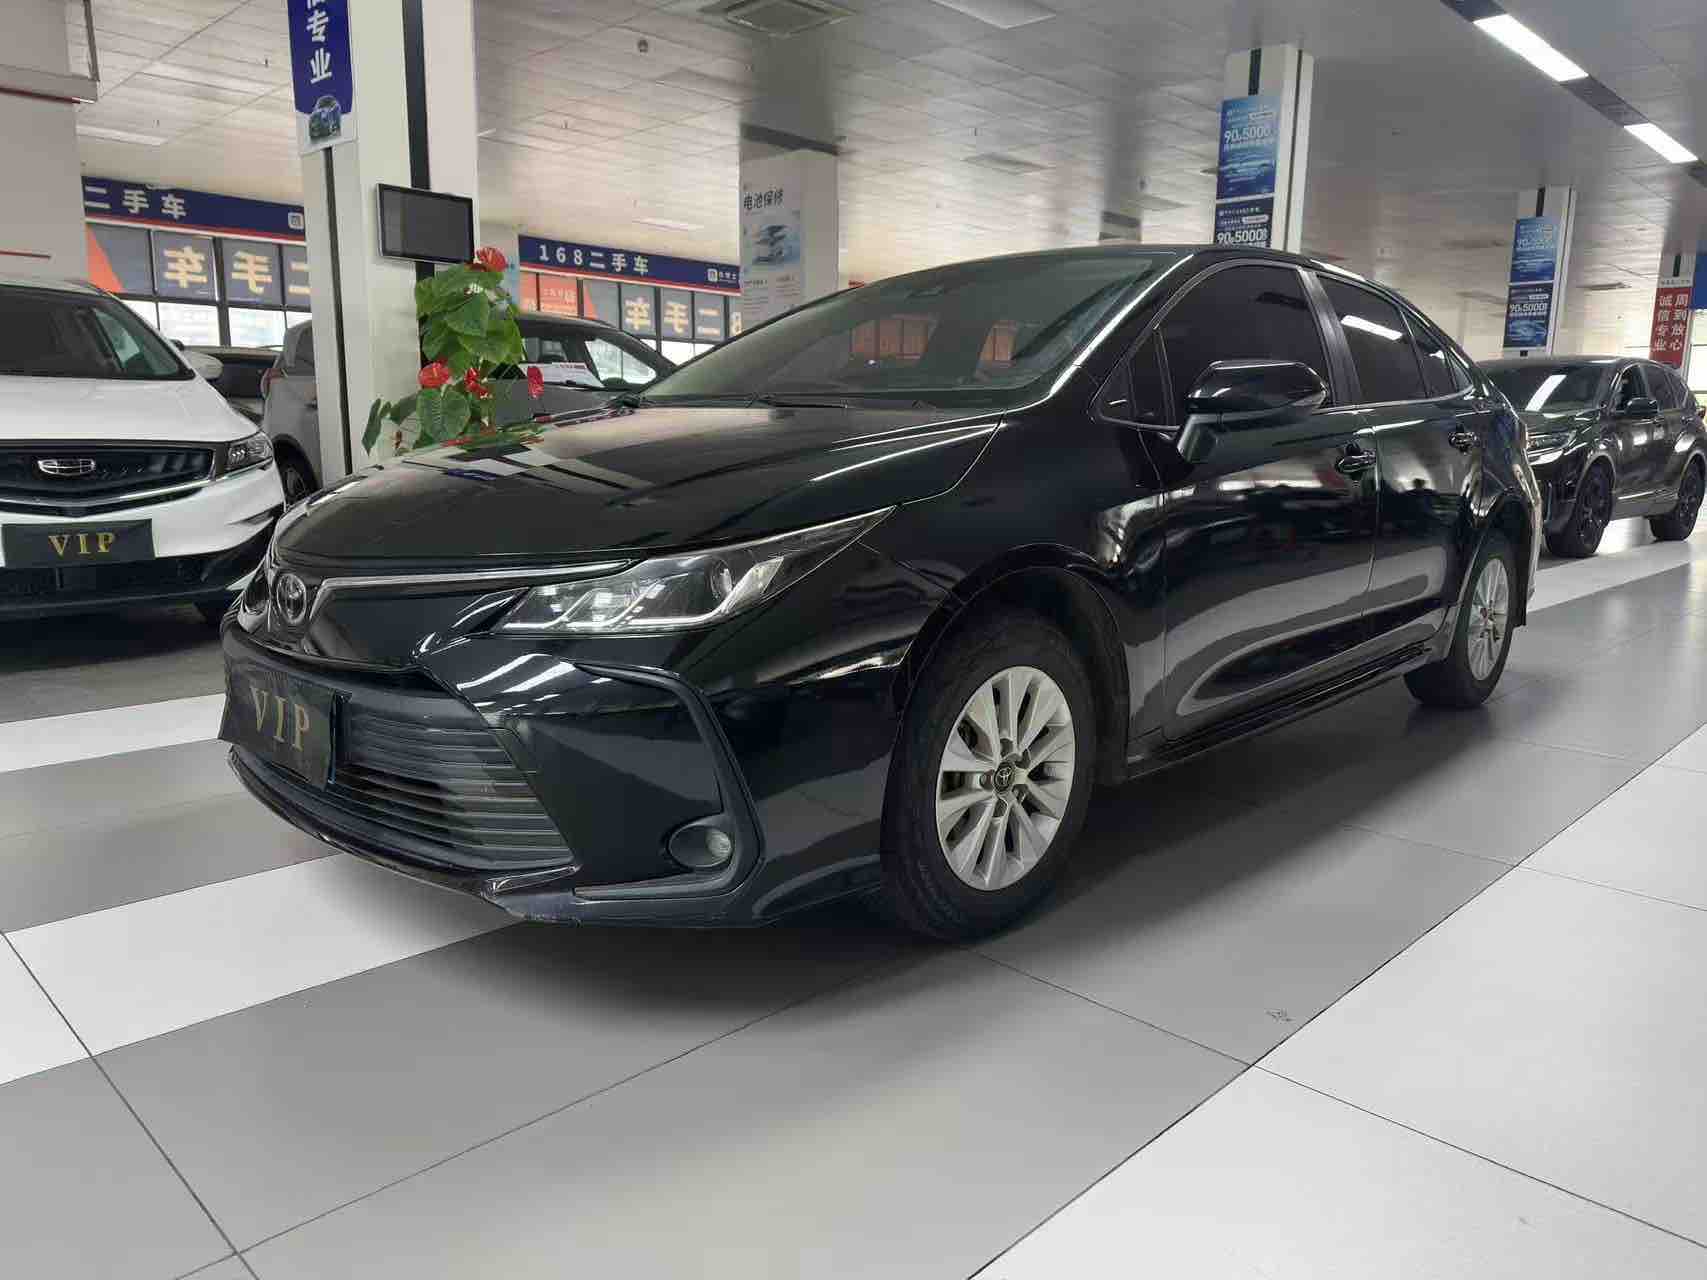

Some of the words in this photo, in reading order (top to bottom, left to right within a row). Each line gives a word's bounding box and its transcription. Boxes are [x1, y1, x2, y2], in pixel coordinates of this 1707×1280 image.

[84, 186, 186, 219] 二手车
[538, 243, 649, 275] 168二手车
[48, 531, 116, 556] VIP
[251, 686, 310, 750] VIP
